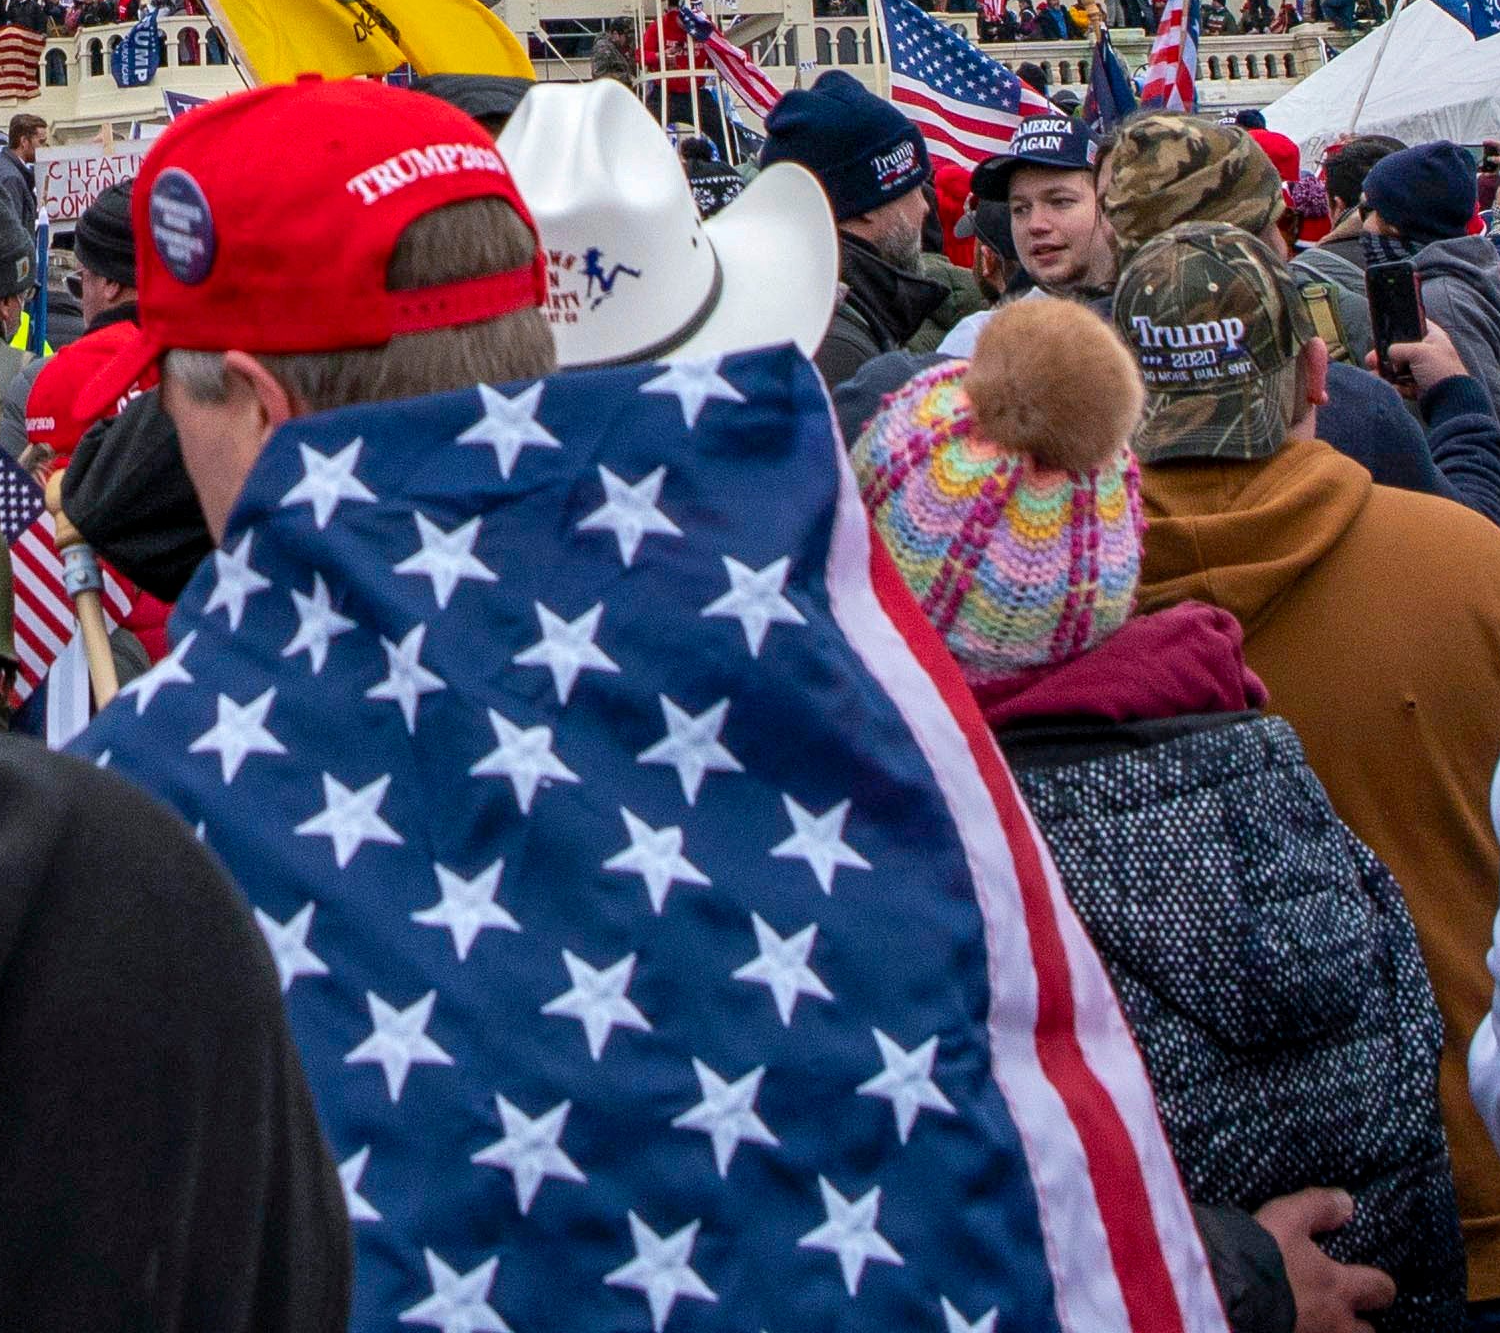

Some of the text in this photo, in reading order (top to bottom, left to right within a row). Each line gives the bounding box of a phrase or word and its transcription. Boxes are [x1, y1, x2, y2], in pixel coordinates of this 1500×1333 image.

[1019, 136, 1063, 153] AGAIN
[870, 140, 916, 174] Trump
[1131, 315, 1245, 352] Trump
[1170, 348, 1217, 369] 2020
[1227, 361, 1252, 376] SHIT
